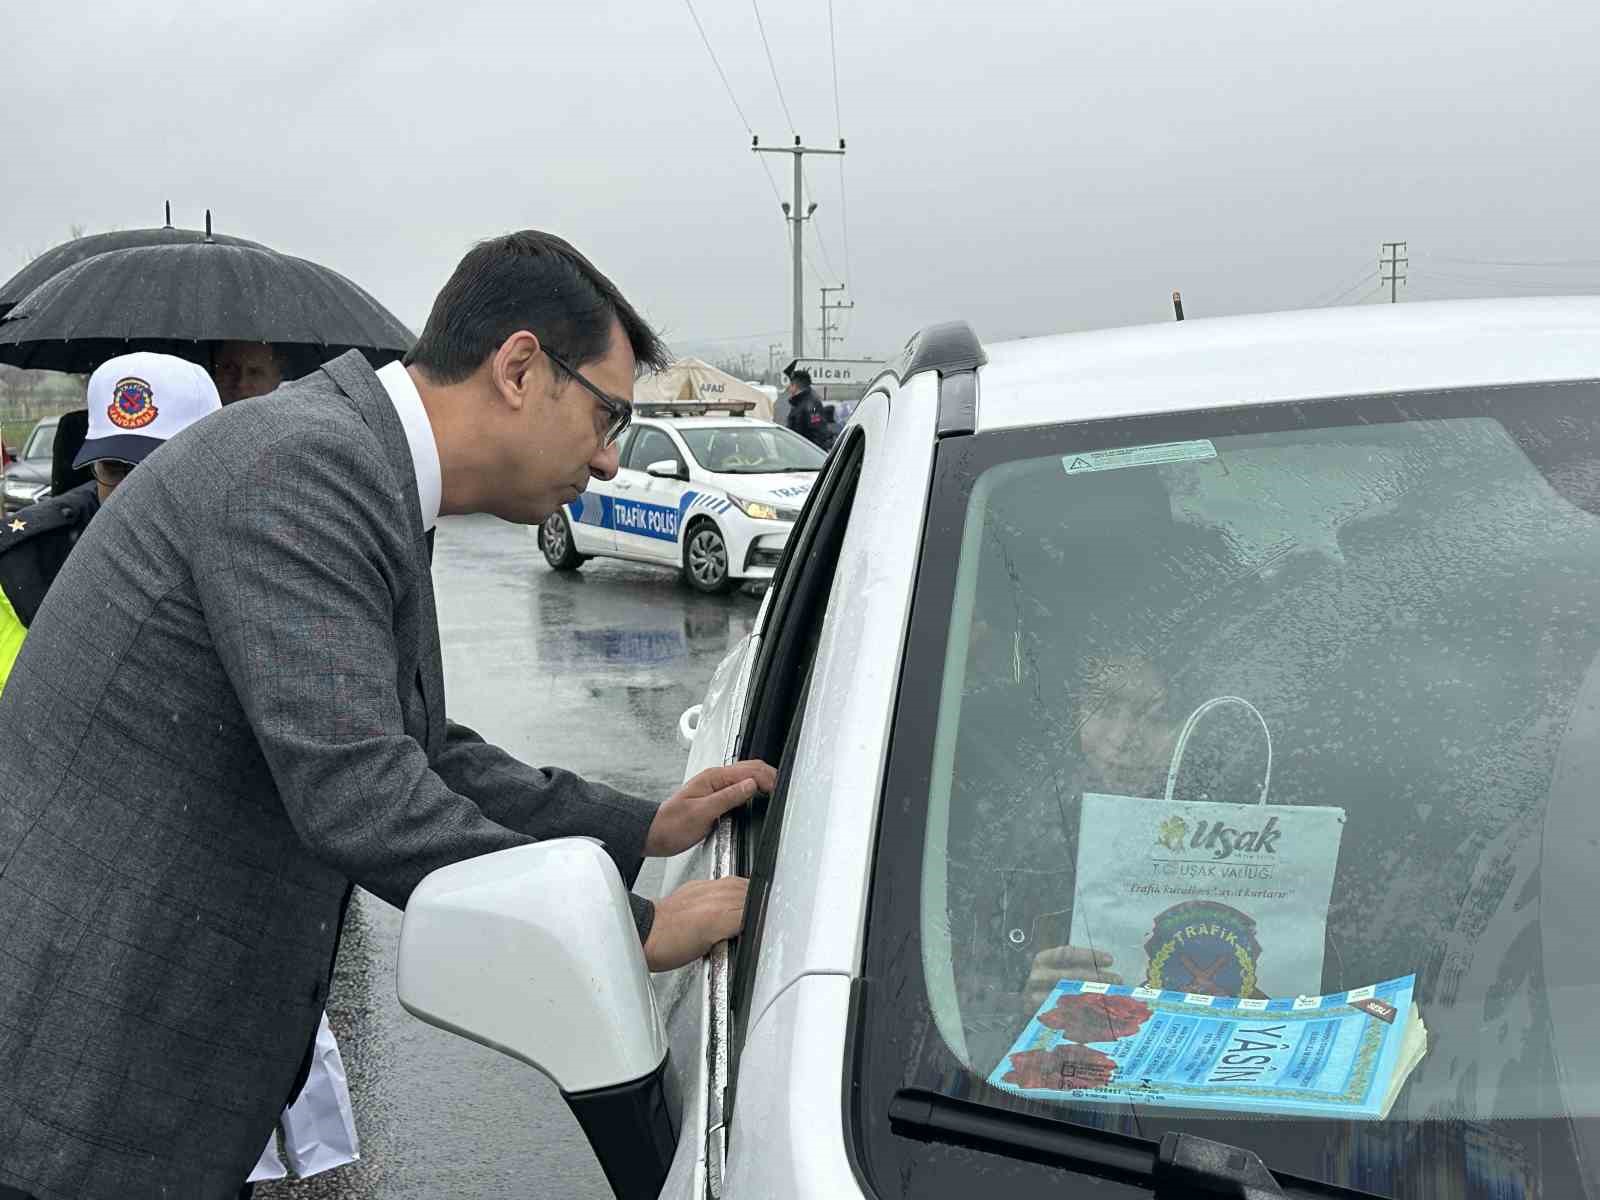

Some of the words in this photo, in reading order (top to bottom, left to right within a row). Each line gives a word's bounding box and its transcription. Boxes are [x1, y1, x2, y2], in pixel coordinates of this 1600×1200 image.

[700, 383, 725, 393] AFAD
[615, 503, 647, 529] TRAFİK
[648, 509, 678, 536] POLİSİ
[1189, 816, 1282, 860] Uşak
[1173, 923, 1239, 946] TRAFİK
